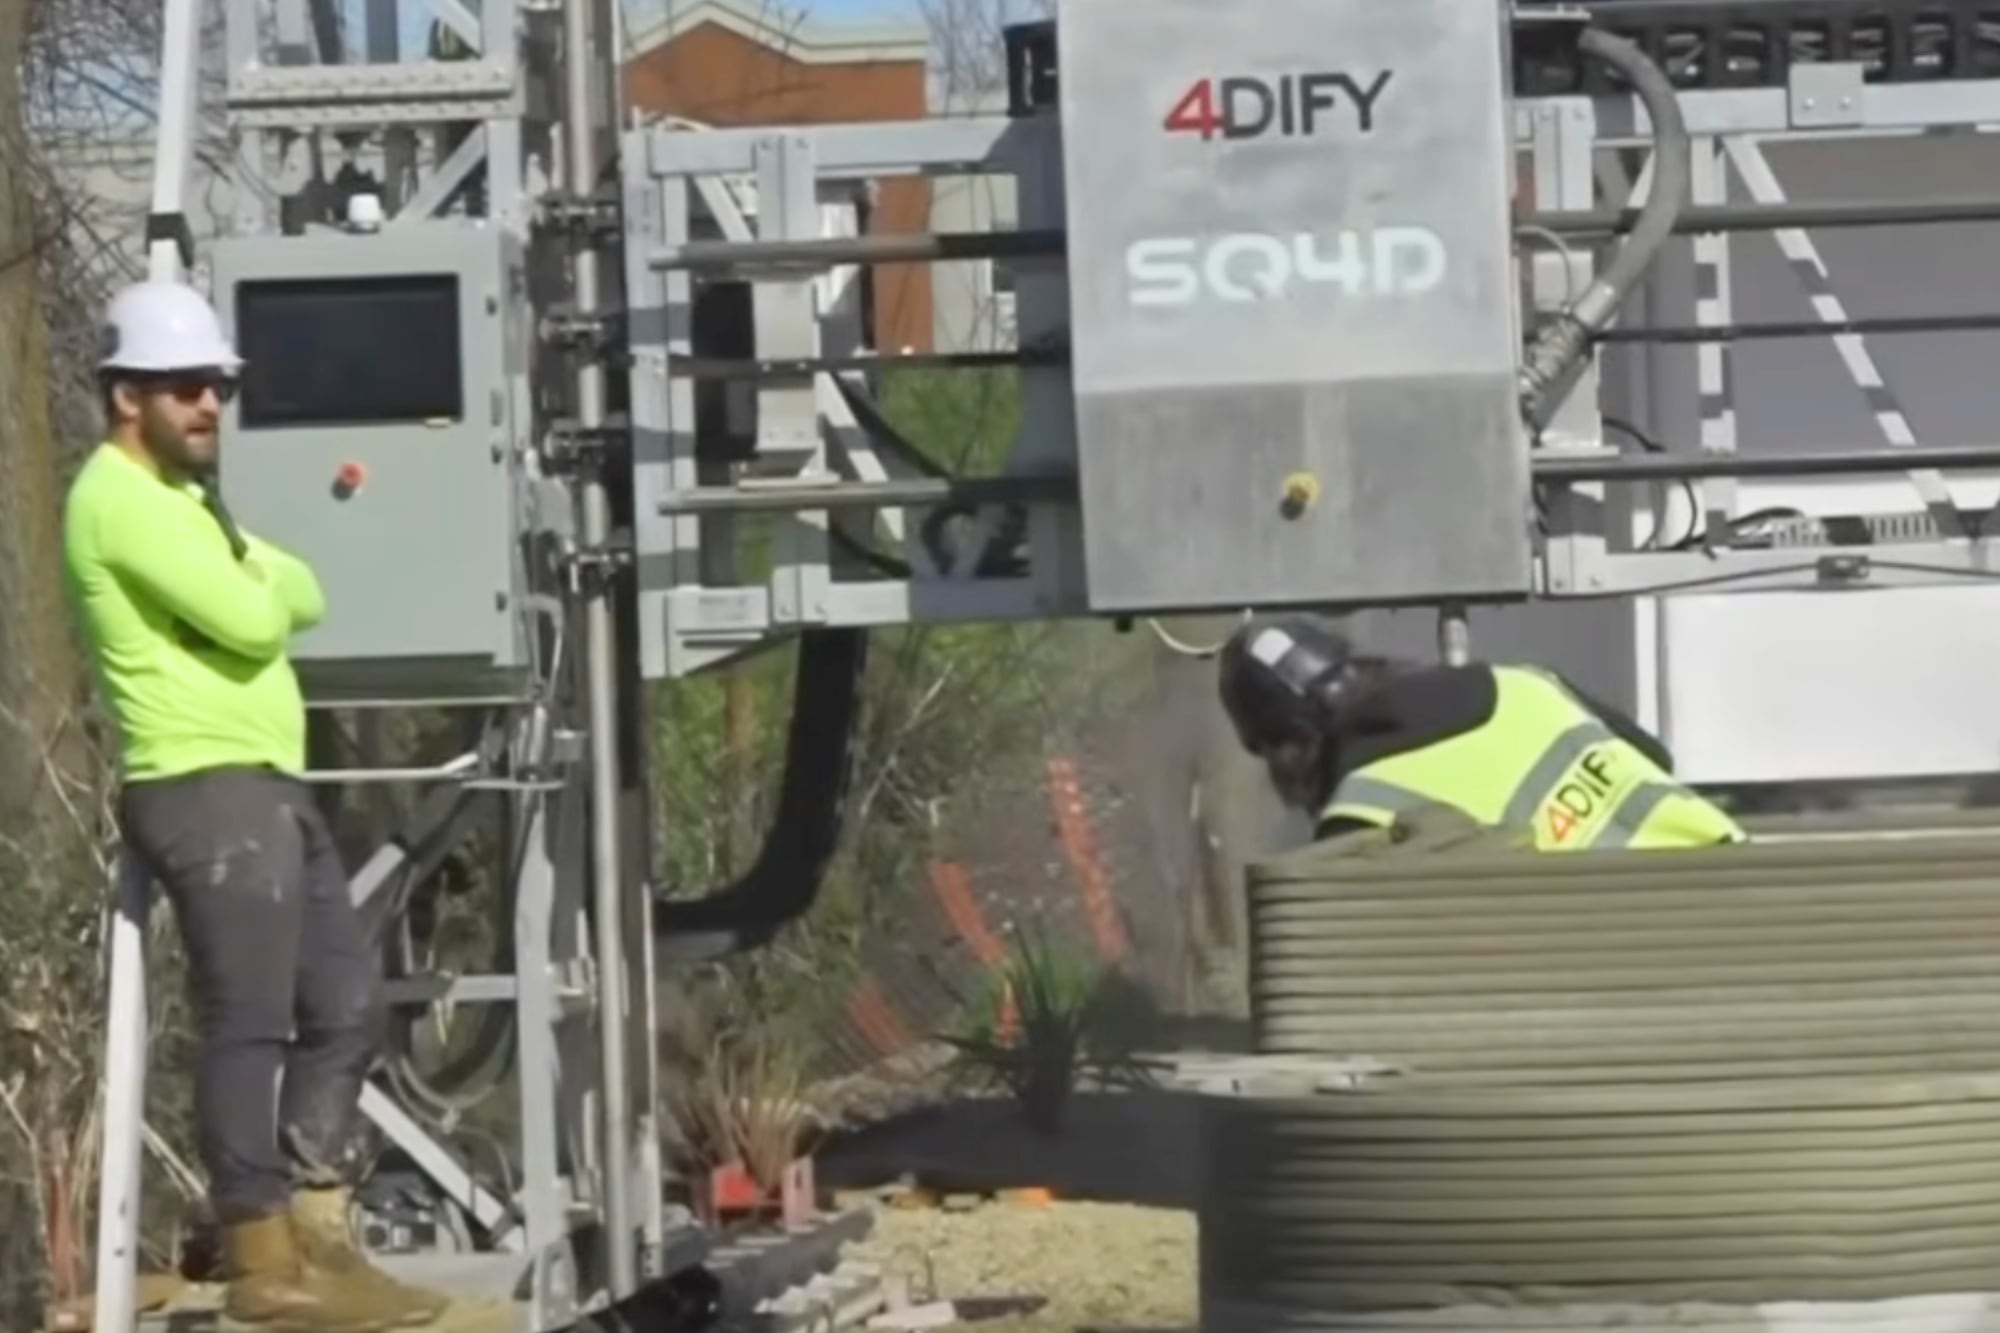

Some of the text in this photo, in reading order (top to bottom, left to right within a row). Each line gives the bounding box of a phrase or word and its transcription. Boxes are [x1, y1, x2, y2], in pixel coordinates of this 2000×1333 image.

[1162, 69, 1393, 141] 4DIFY
[1126, 225, 1446, 304] SQ4D
[1547, 750, 1616, 842] 4DIF
